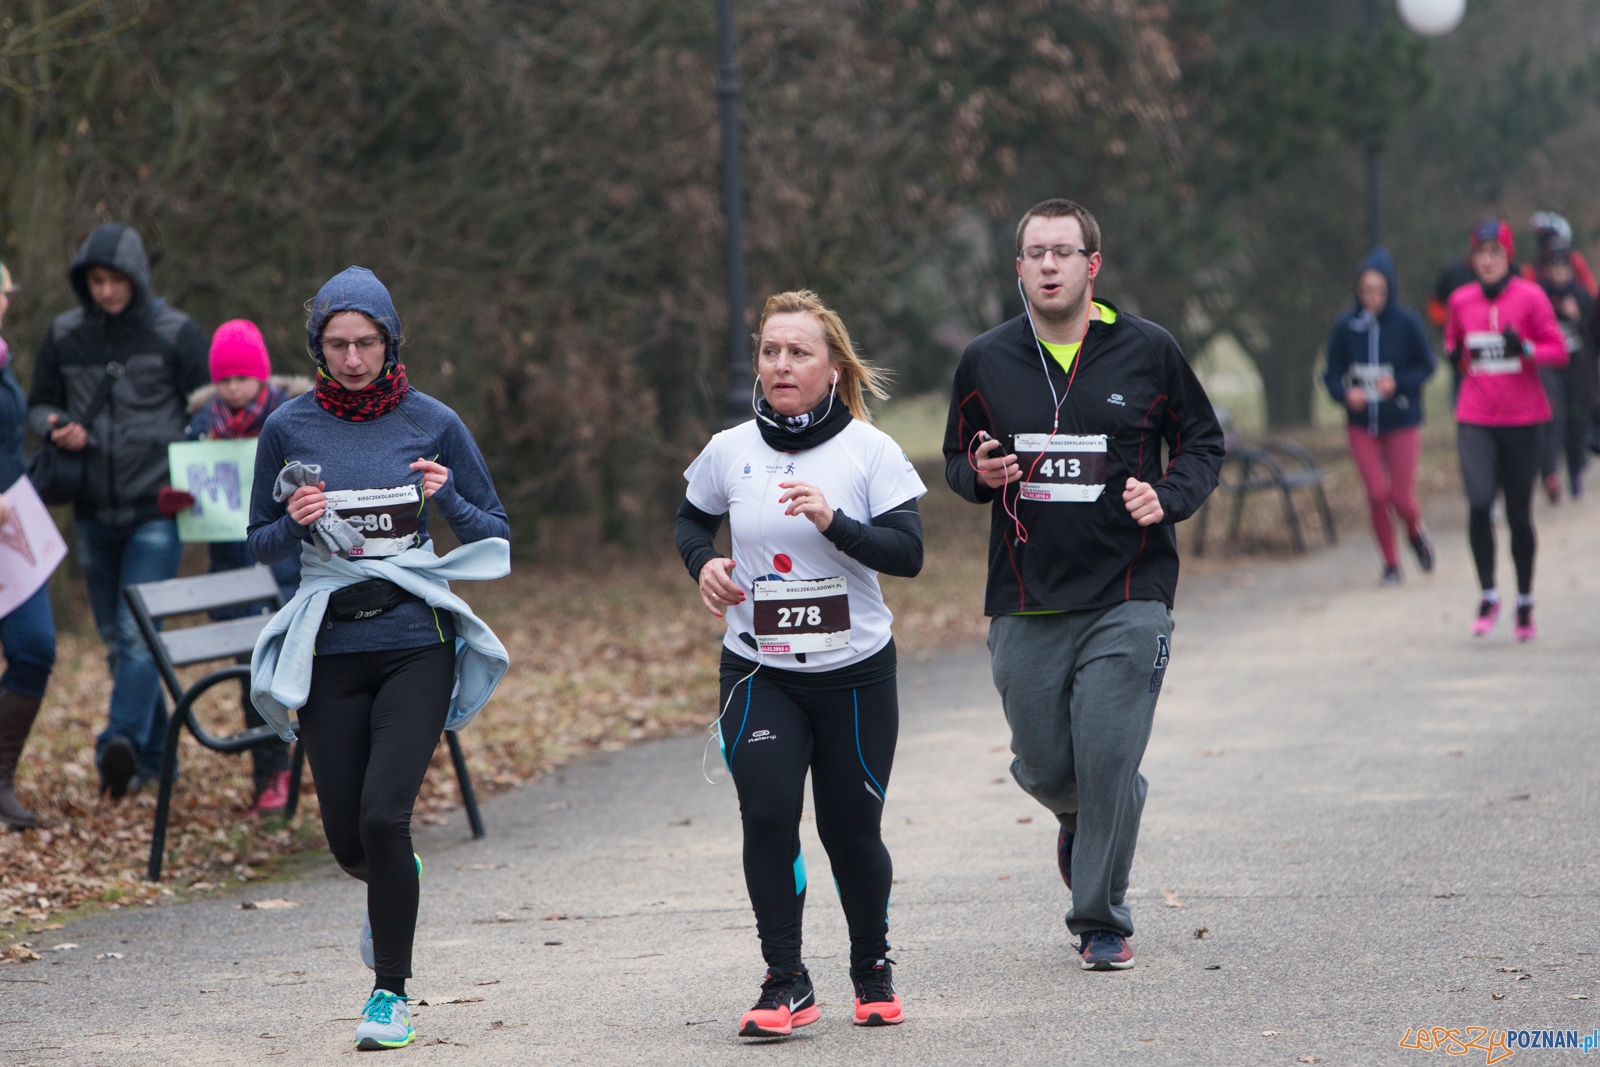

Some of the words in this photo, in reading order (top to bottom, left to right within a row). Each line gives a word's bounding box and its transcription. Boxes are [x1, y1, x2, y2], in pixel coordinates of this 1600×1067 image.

[1040, 458, 1081, 478] 413
[186, 461, 242, 516] M
[357, 492, 414, 501] BIEGCZEKOLADOWY.PL
[786, 584, 842, 592] BIEGCZEKOLADOWY.PL
[777, 605, 822, 628] 278
[1153, 634, 1170, 669] A
